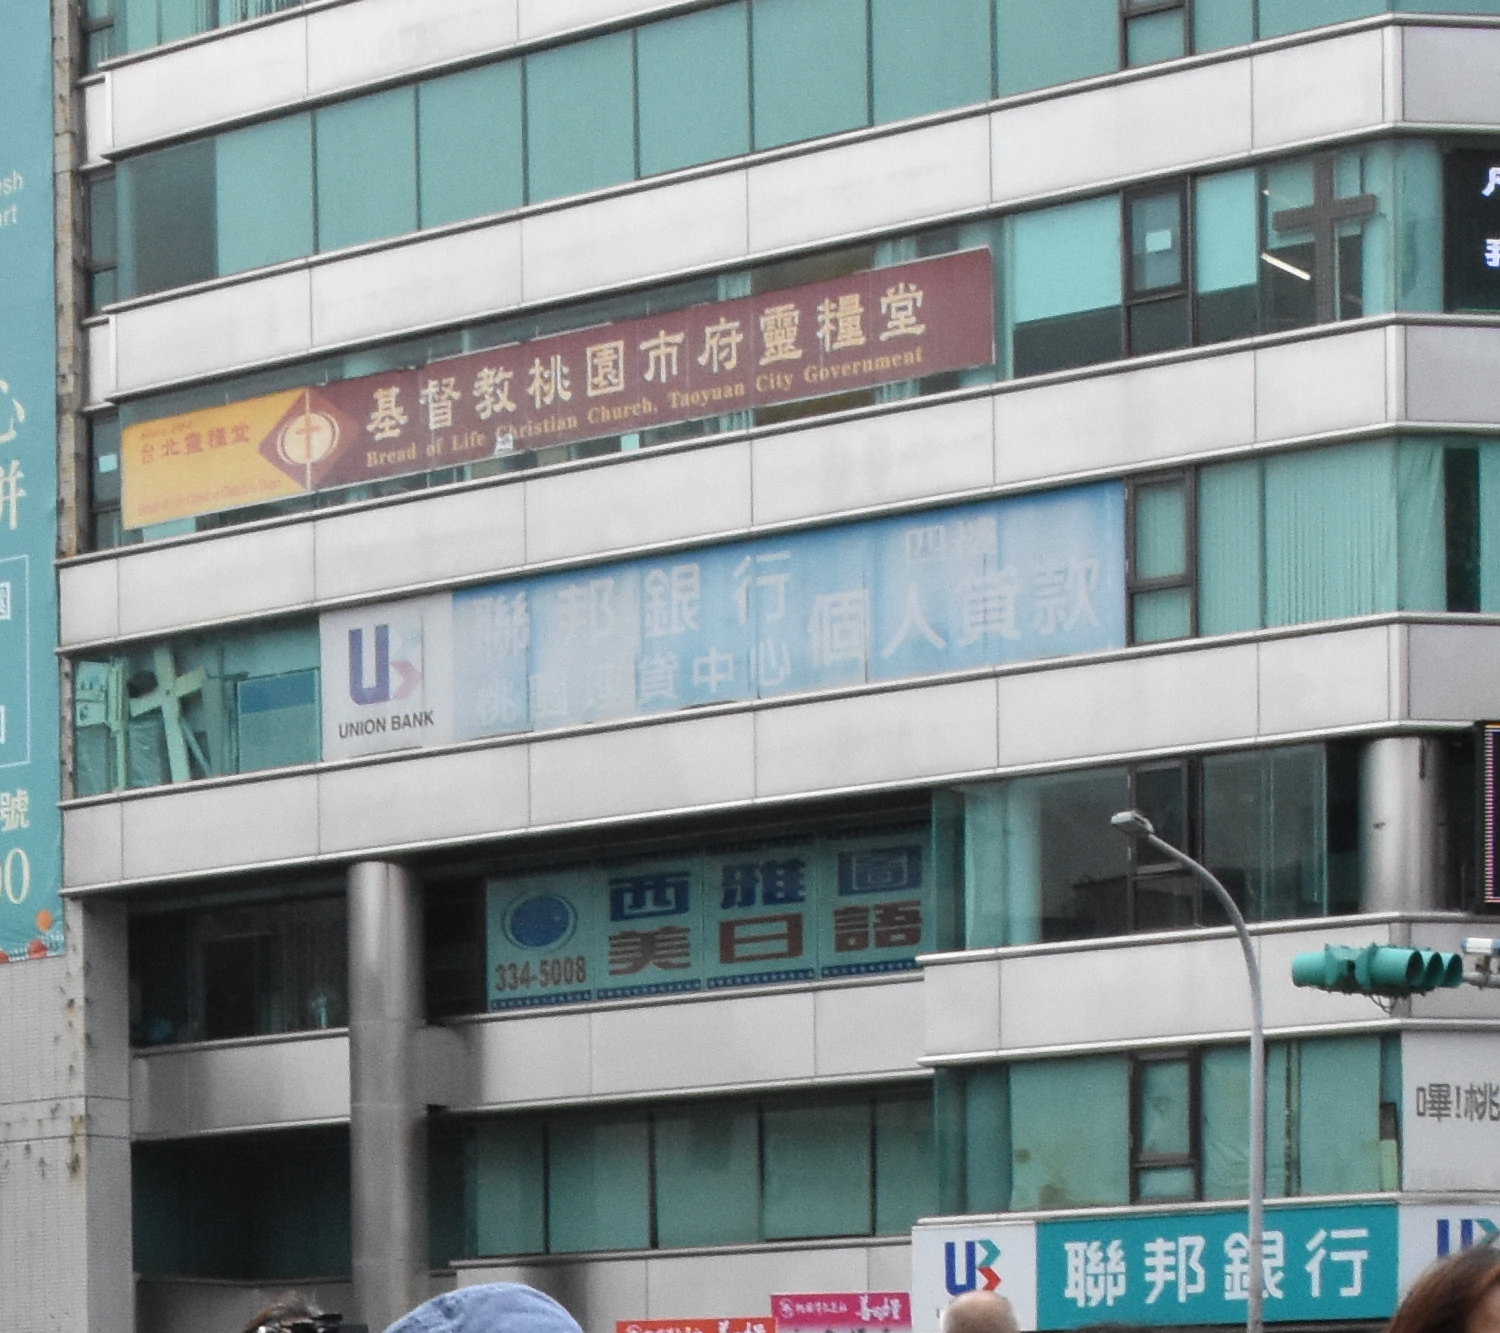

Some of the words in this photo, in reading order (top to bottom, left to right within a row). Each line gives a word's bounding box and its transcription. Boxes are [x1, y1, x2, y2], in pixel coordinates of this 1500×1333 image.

[366, 282, 927, 442] 基督教桃園市府靈糧堂
[366, 447, 417, 468] Bread
[425, 439, 446, 458] of
[451, 431, 486, 452] Life
[494, 413, 579, 444] Christian
[669, 380, 746, 415] Taoyuan
[755, 371, 796, 395] City
[804, 347, 926, 386] Government
[470, 548, 794, 658] 聯邦銀行
[807, 556, 1101, 667] 個人貸款
[338, 716, 389, 739] UNION
[391, 709, 435, 733] BANK
[496, 957, 588, 992] 334-5008
[608, 900, 924, 977] 美日語
[1064, 1227, 1371, 1309] 聯邦銀行
